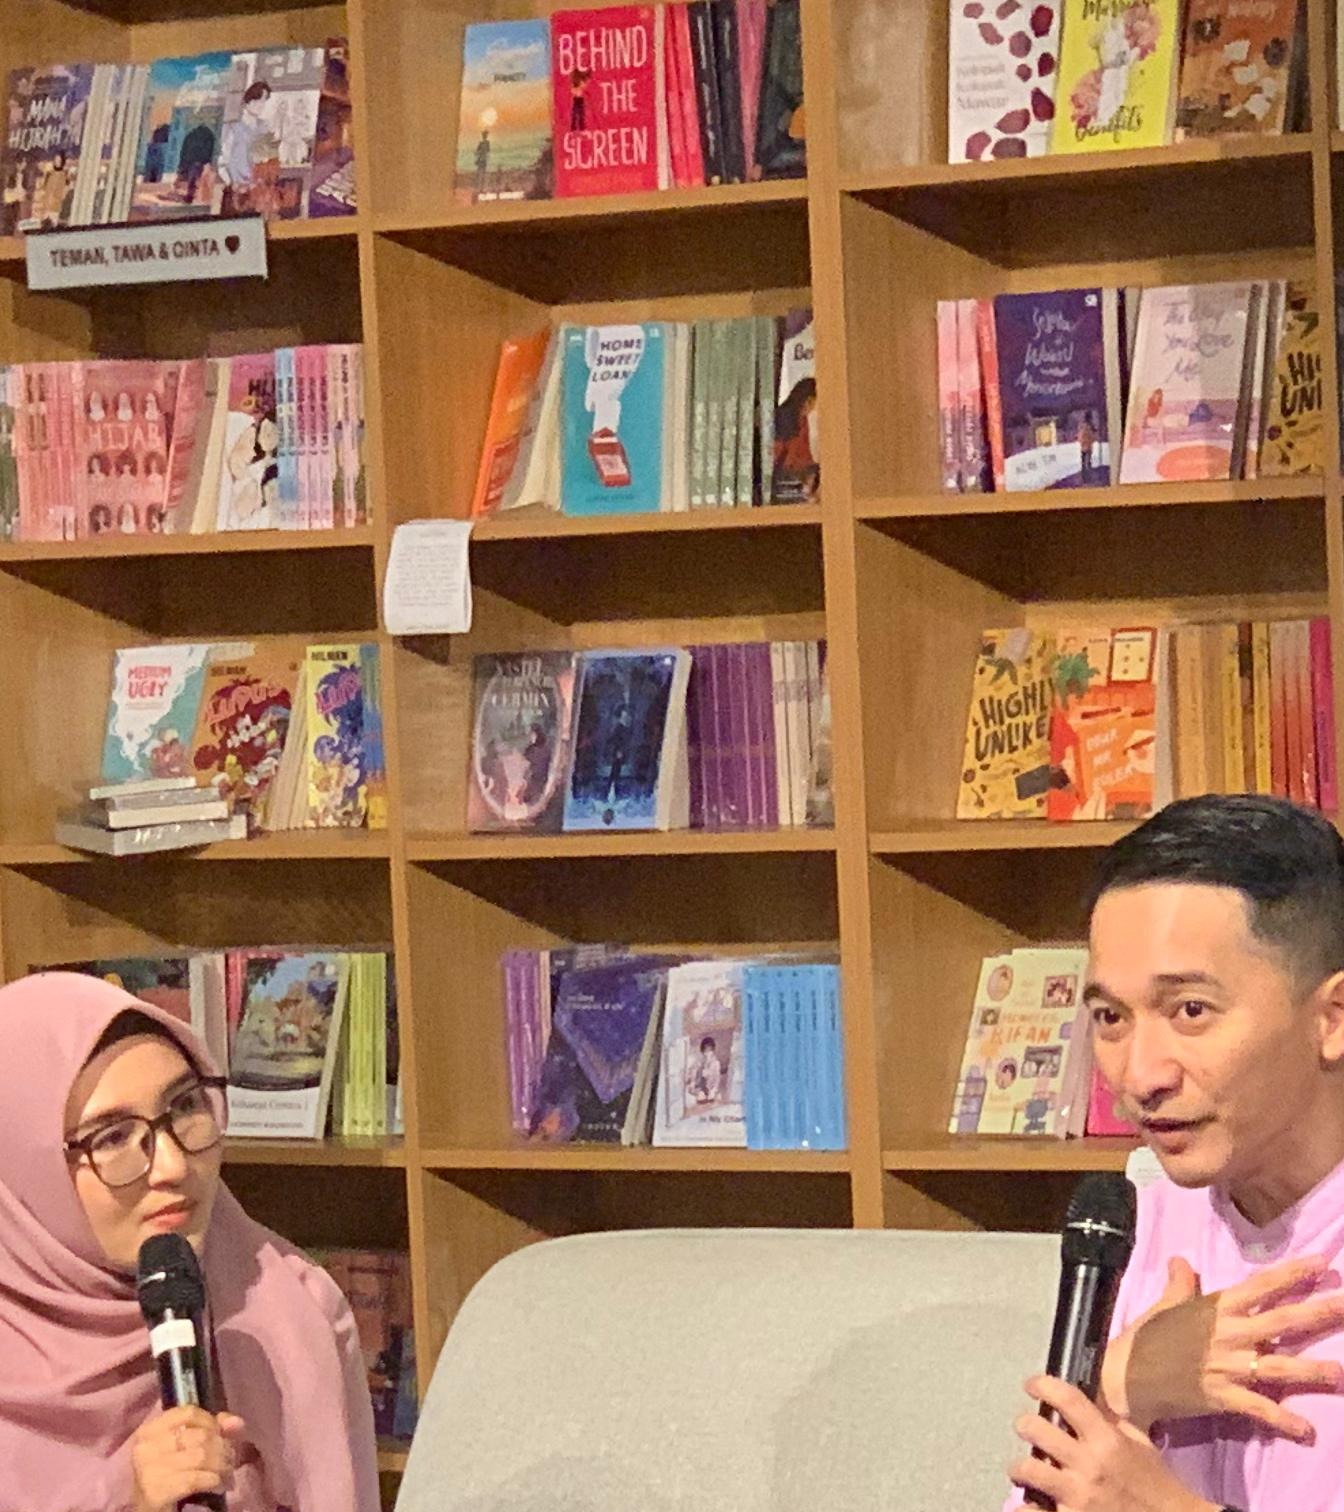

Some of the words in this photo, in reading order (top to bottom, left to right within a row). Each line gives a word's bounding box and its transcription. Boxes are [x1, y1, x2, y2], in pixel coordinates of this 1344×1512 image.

[559, 25, 647, 75] BEHIND
[599, 79, 638, 114] THE
[563, 126, 648, 170] SCREEN
[50, 246, 108, 268] TEMAN,
[111, 243, 155, 263] TAWA
[158, 242, 169, 260] &
[172, 238, 220, 260] CINTA
[596, 353, 640, 367] SWEET
[600, 338, 642, 352] HOME
[592, 369, 632, 383] LOAN
